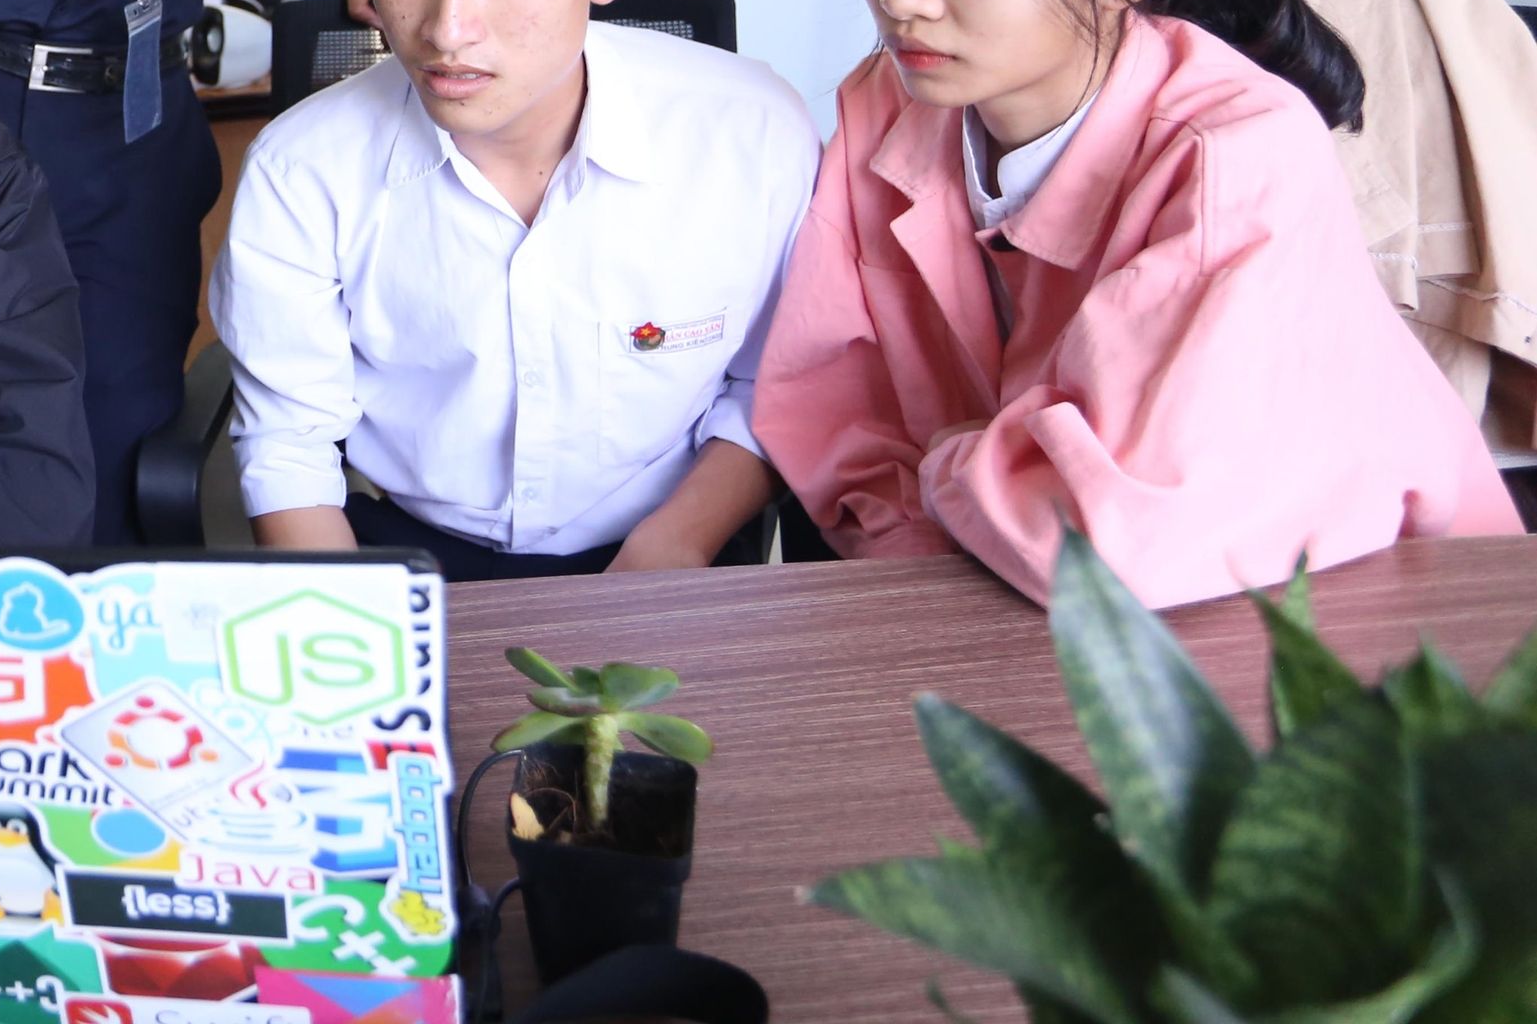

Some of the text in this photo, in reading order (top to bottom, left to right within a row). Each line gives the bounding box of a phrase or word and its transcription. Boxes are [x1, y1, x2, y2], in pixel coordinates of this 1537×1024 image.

[267, 631, 376, 706] JS
[394, 756, 442, 894] hadoop
[181, 854, 316, 891] Java
[122, 884, 231, 925] {less}
